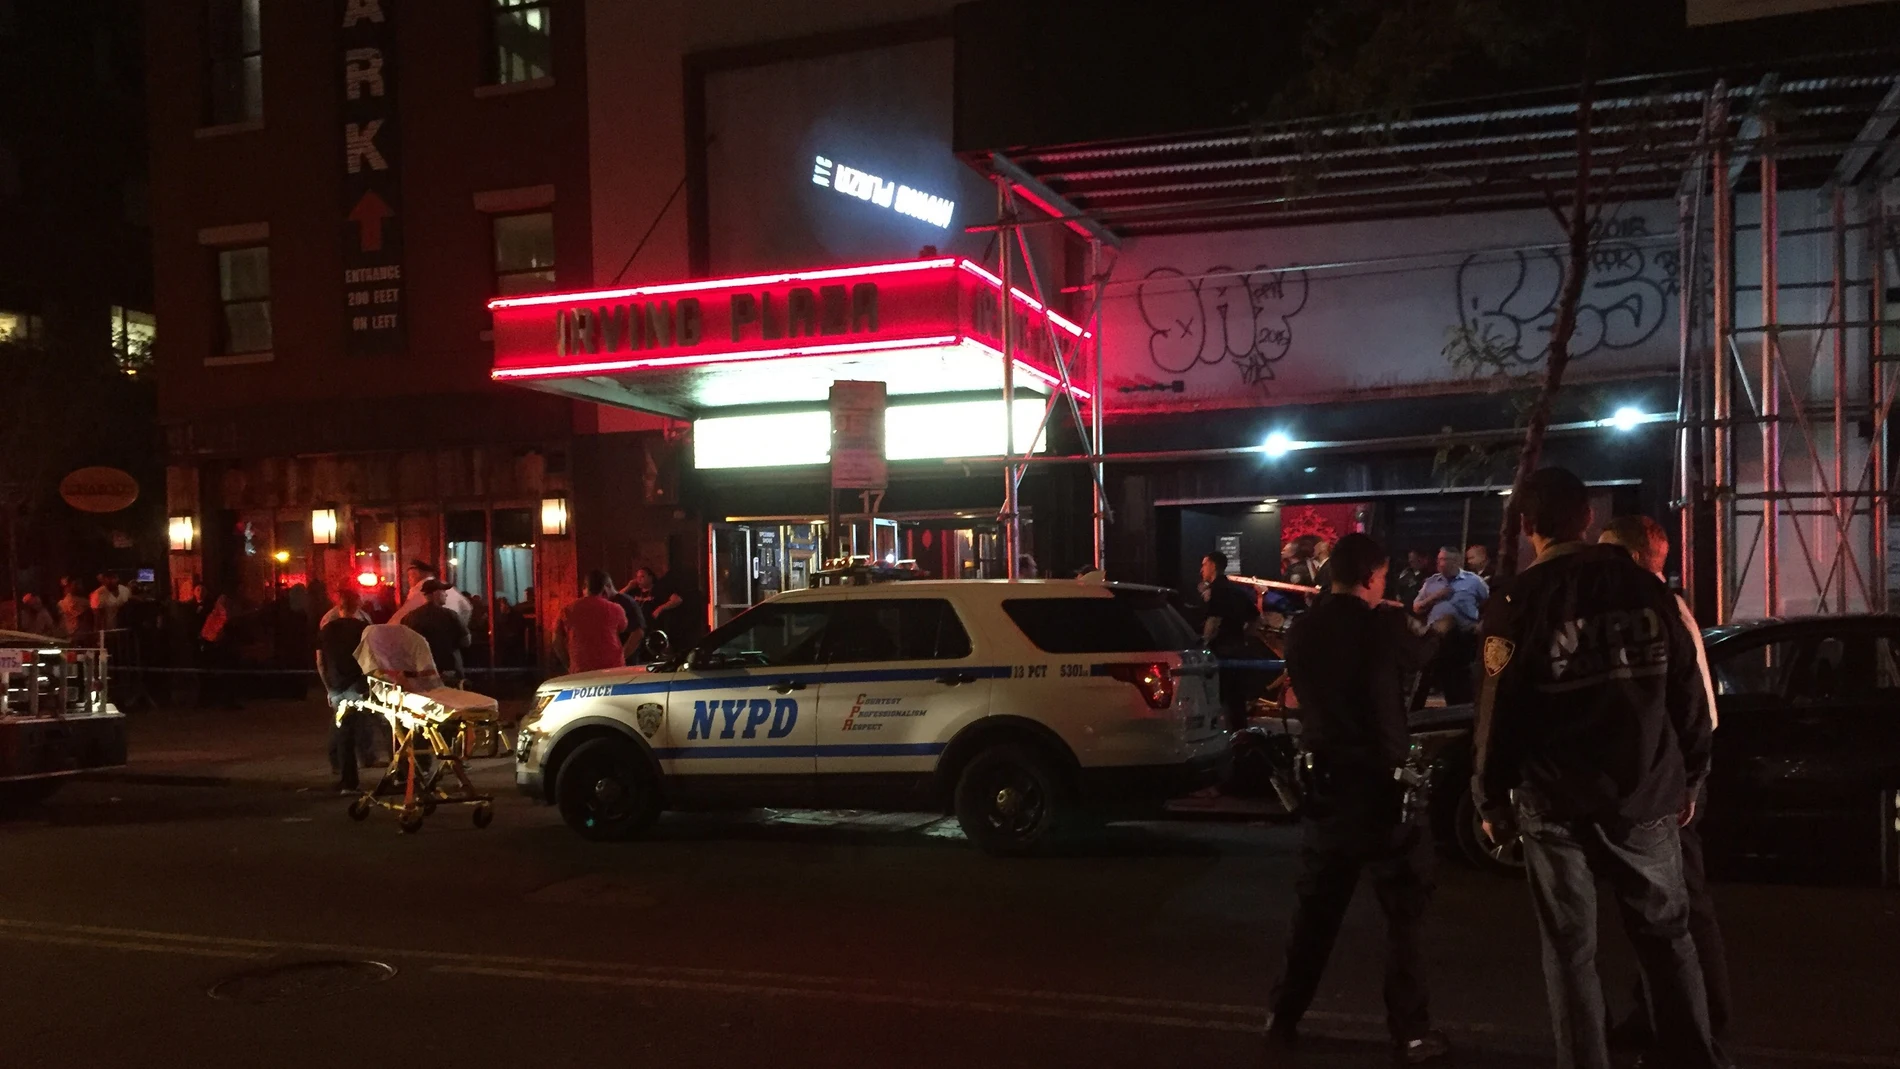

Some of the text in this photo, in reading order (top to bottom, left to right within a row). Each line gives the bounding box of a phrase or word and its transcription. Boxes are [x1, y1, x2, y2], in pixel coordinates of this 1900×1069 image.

[344, 265, 400, 283] ENTRANCE
[348, 288, 399, 306] 200 FEET
[352, 313, 397, 331] ON LEFT
[556, 282, 878, 357] IRVING PLAZA
[858, 489, 885, 513] 17
[1549, 607, 1660, 659] NYPD
[1551, 640, 1668, 680] POLICE
[1013, 665, 1025, 679] 13
[1028, 664, 1048, 678] PCT
[573, 685, 613, 699] POLICE
[687, 698, 799, 740] NYPD
